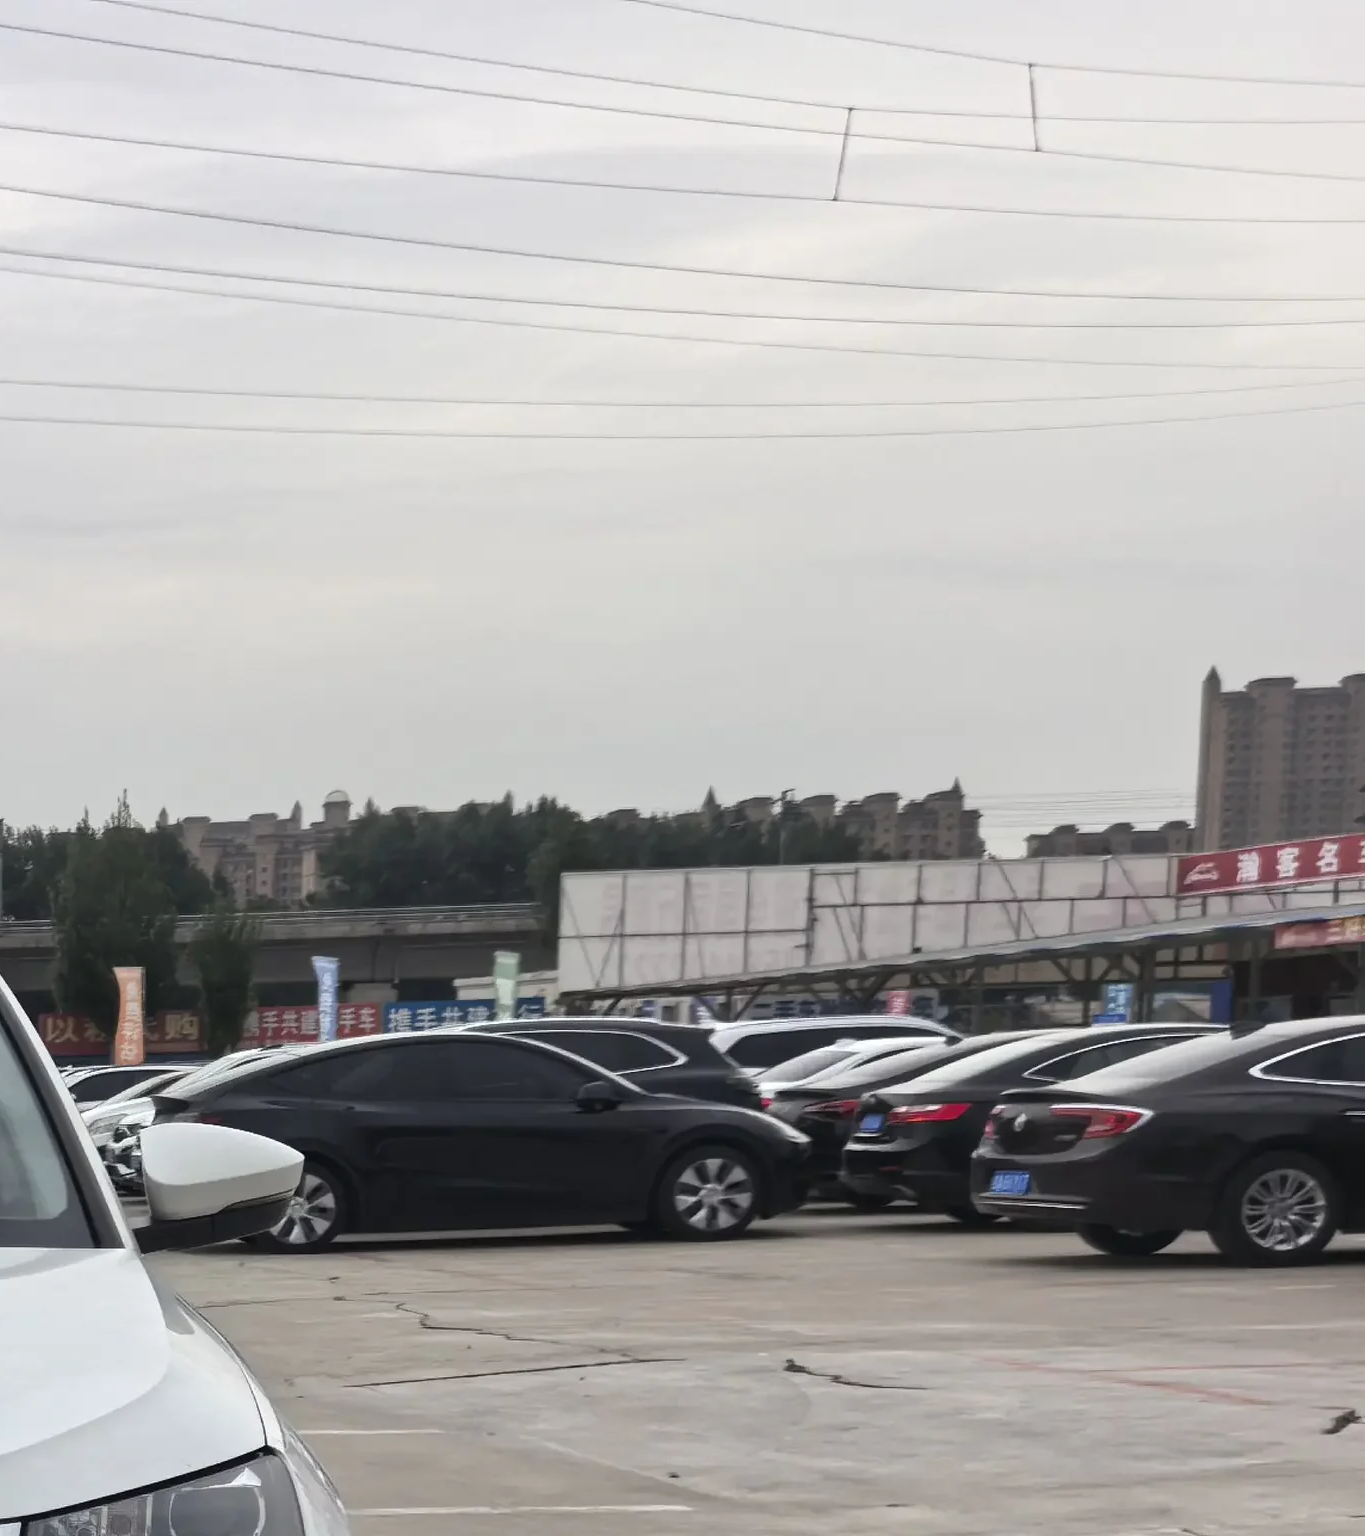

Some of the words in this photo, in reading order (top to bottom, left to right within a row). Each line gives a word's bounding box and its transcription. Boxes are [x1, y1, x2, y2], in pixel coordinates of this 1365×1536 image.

[242, 1006, 377, 1037] 携手共建手车
